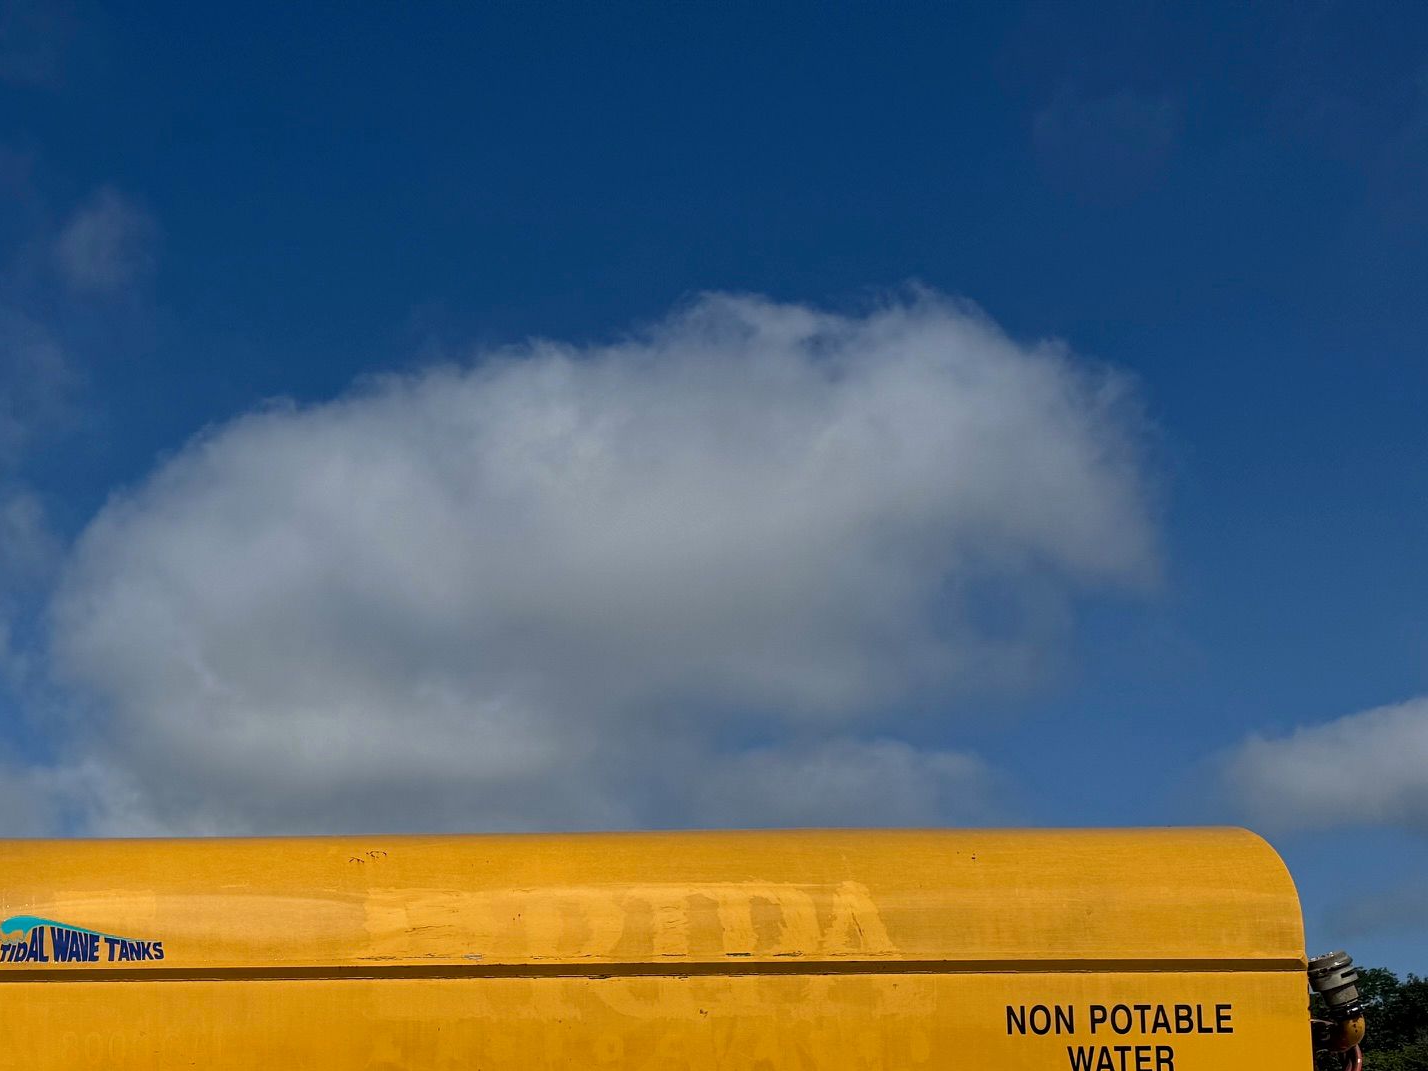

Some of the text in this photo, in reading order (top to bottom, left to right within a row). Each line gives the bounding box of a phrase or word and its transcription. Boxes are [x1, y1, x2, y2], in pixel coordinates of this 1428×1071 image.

[0, 926, 165, 963] TIDAL WAVE TANKS
[1005, 1004, 1234, 1035] NON POTABLE
